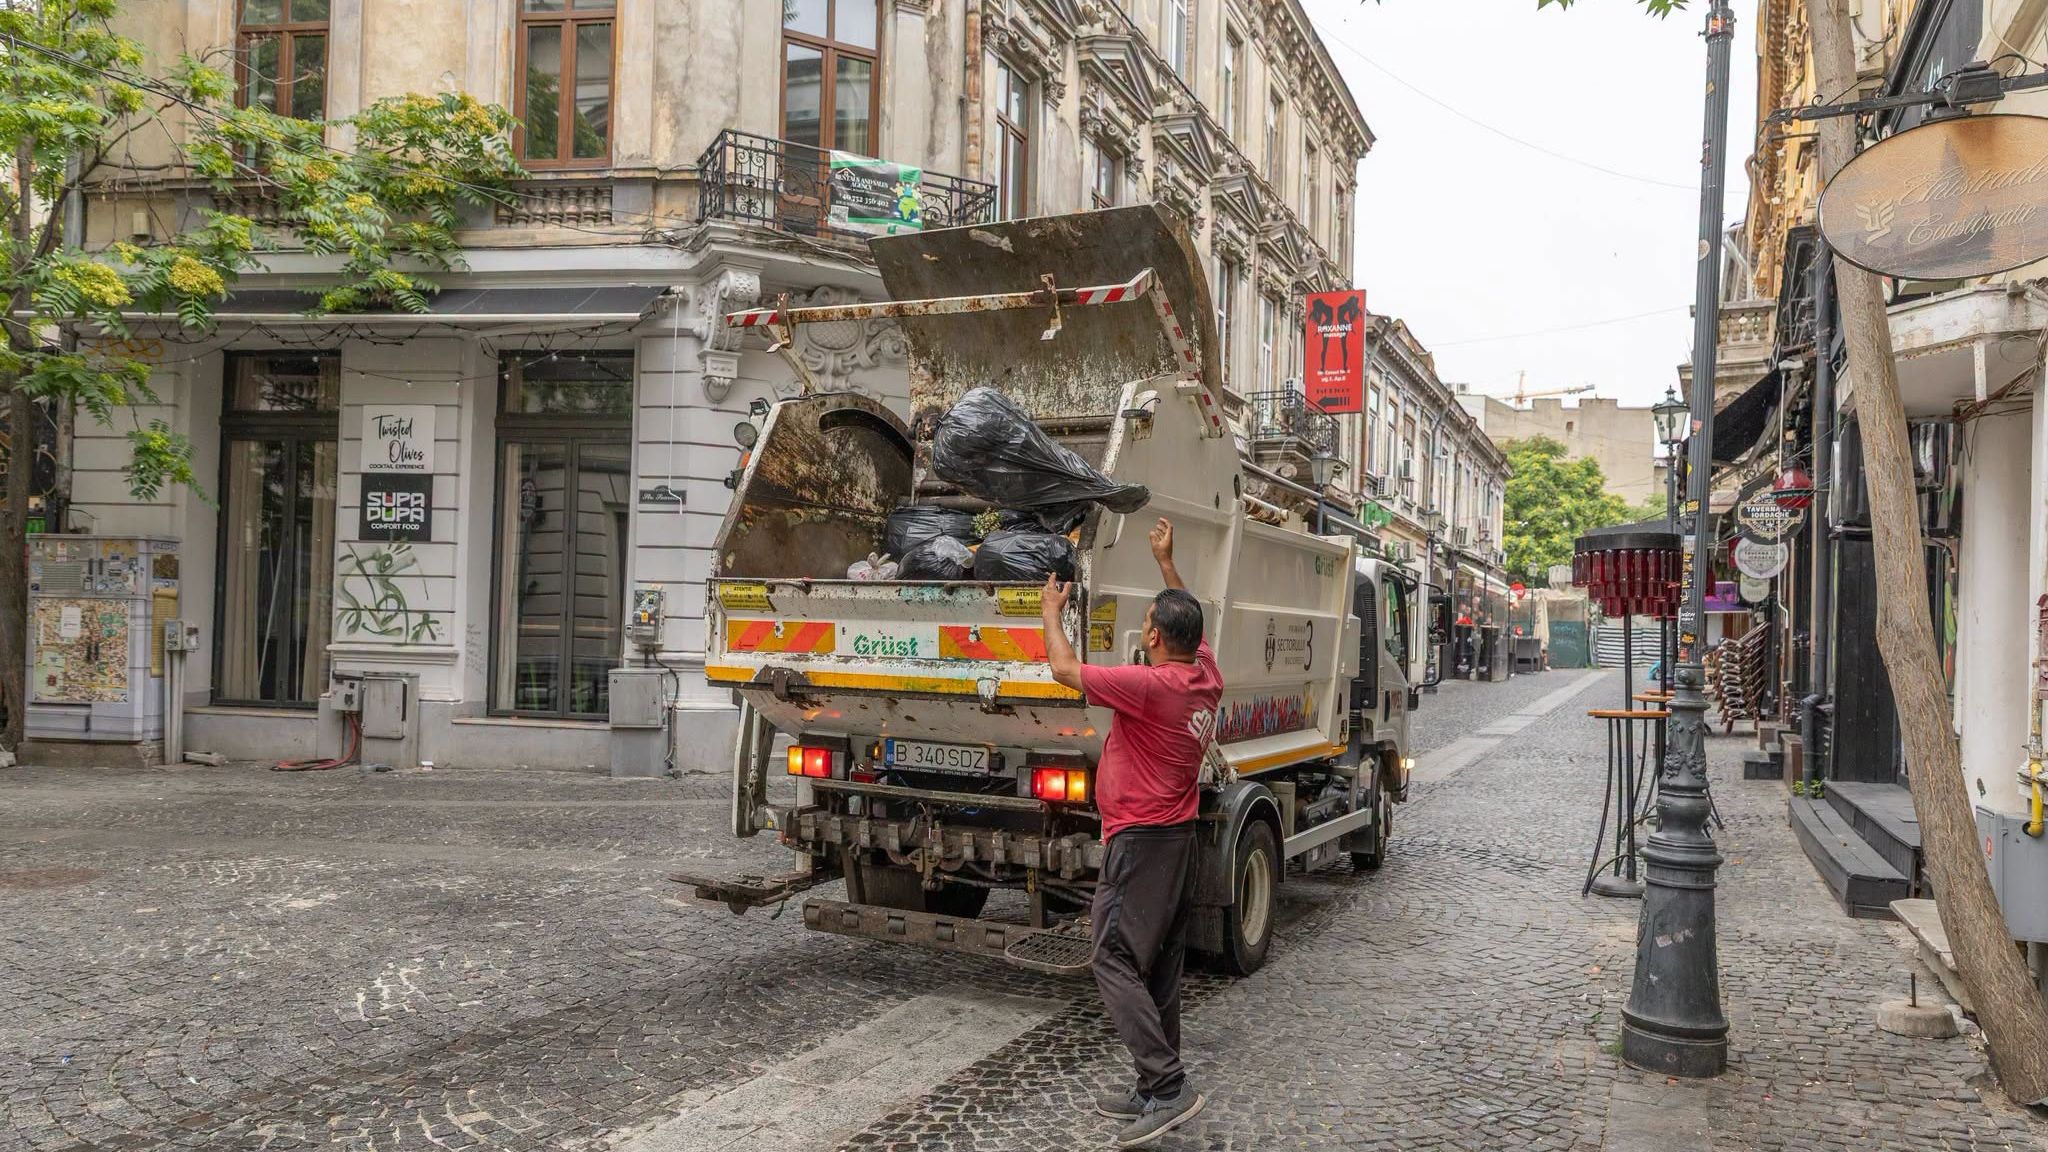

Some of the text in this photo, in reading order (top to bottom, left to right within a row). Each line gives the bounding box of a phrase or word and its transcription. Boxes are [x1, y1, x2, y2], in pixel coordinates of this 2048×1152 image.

[1317, 324, 1352, 332] ROXANNE
[371, 414, 413, 440] Twisted
[389, 439, 425, 463] Olives
[367, 491, 425, 507] SUPA
[366, 507, 425, 522] DUPA
[1315, 555, 1335, 578] Grüst
[853, 633, 919, 656] Grüst
[1304, 619, 1313, 671] 3
[896, 744, 907, 762] B
[914, 746, 945, 765] 340
[948, 748, 985, 769] SDZ
